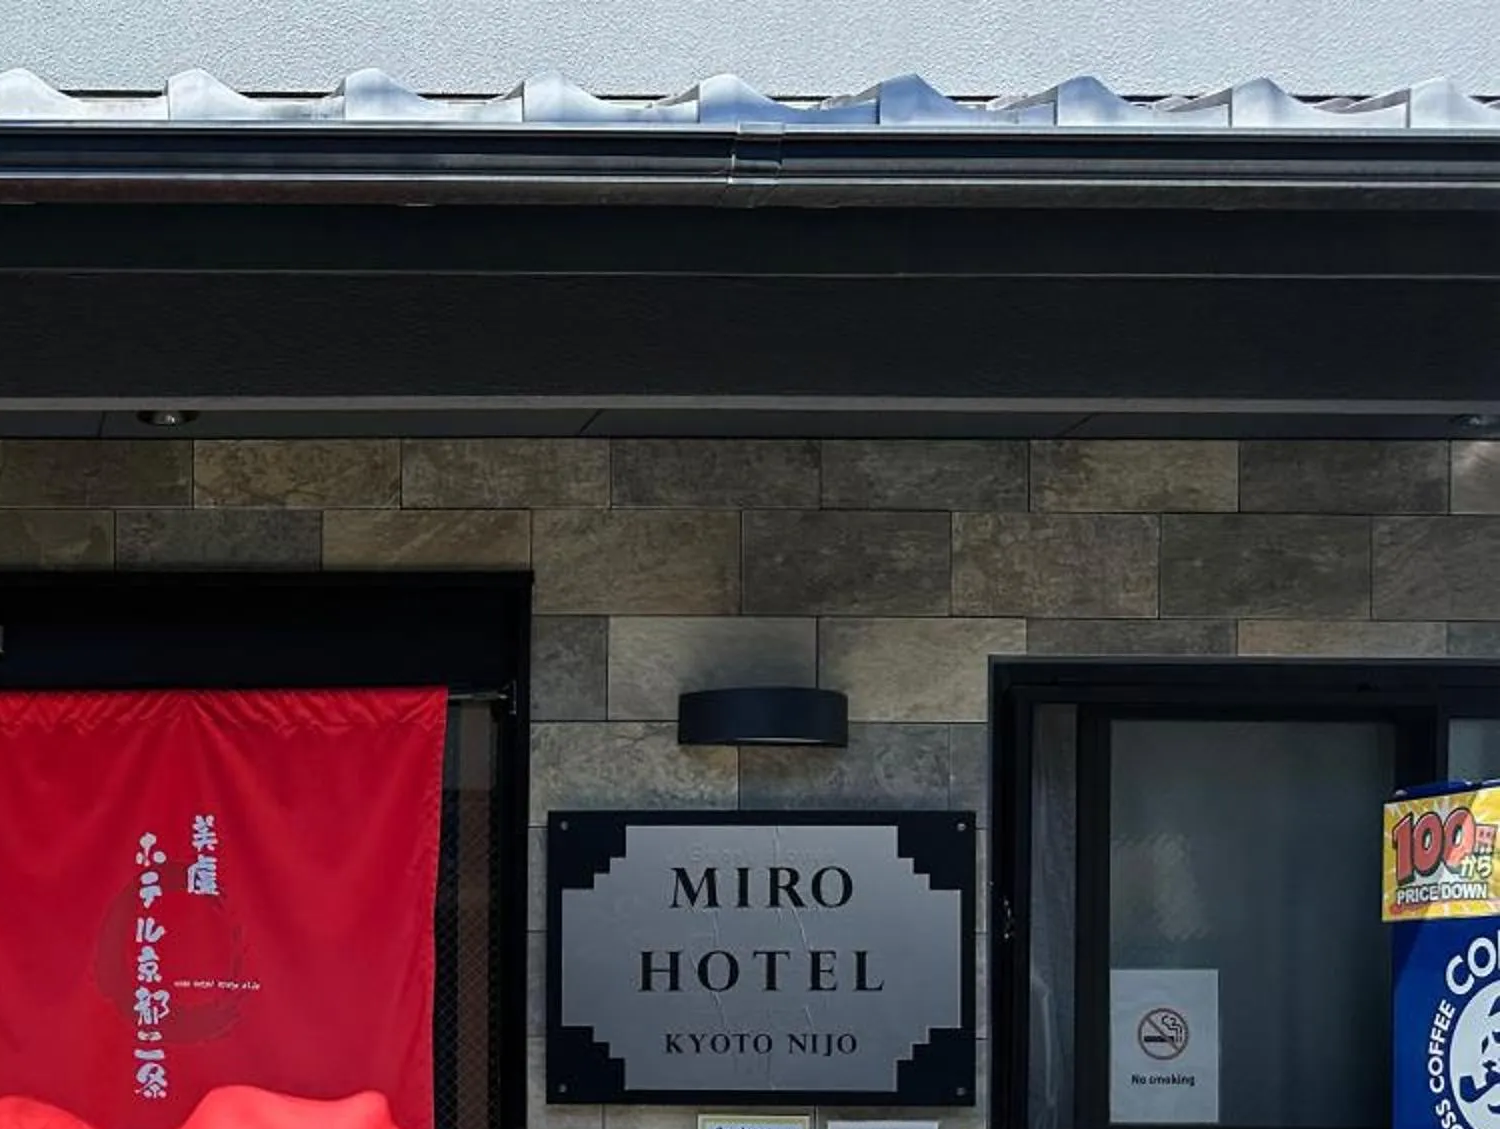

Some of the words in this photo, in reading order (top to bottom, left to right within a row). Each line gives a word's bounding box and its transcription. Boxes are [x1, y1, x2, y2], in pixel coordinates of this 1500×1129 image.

[670, 866, 853, 909] MIRO
[1396, 884, 1439, 904] PRICE
[1440, 881, 1488, 900] DOWN
[638, 950, 885, 992] HOTEL
[1446, 930, 1500, 995] CO
[665, 1034, 773, 1055] KYOTO
[788, 1034, 858, 1057] NIJO
[1428, 1000, 1456, 1093] COFFEE
[1131, 1075, 1147, 1085] No
